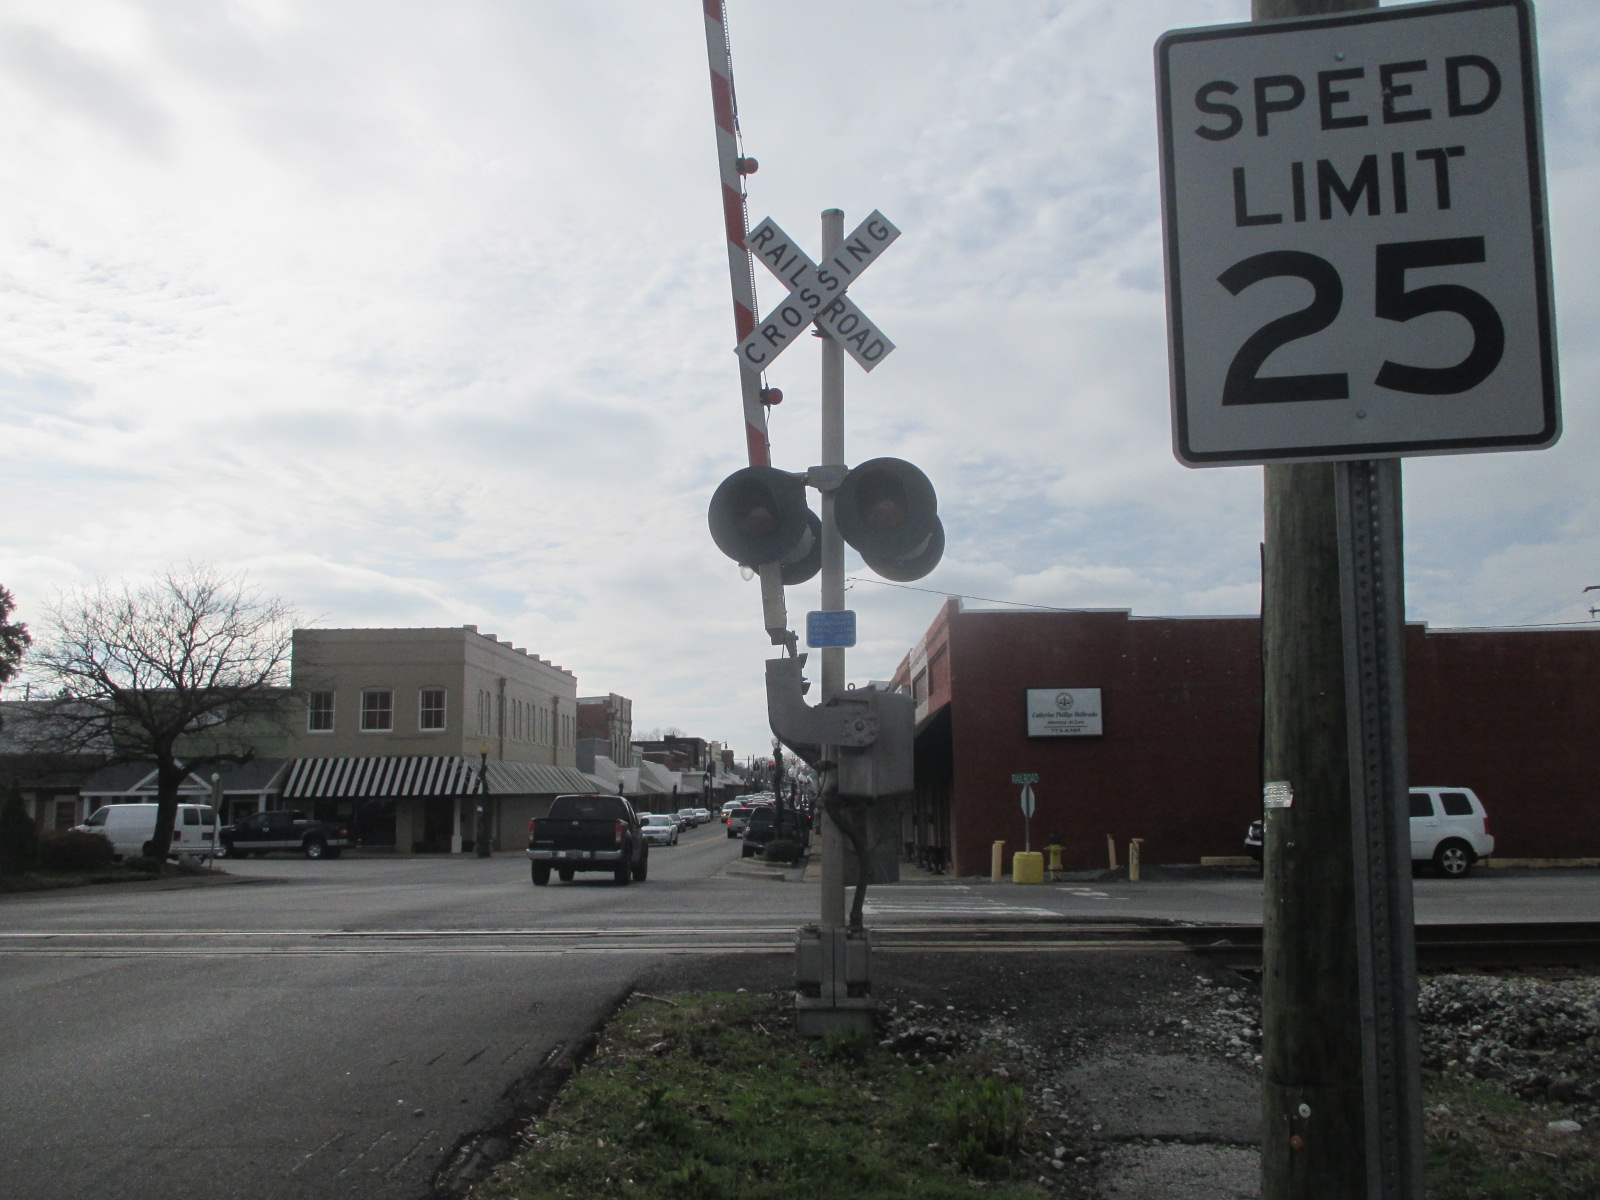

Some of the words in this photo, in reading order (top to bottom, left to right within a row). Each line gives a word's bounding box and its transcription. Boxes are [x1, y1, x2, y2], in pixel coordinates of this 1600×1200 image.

[1194, 54, 1502, 142] SPEED
[1232, 145, 1465, 227] LIMIT
[744, 220, 889, 364] CROSSING
[751, 225, 807, 288] RAIL
[822, 298, 885, 362] ROAD
[1216, 235, 1505, 406] 25
[1011, 773, 1040, 784] RAILROAD
